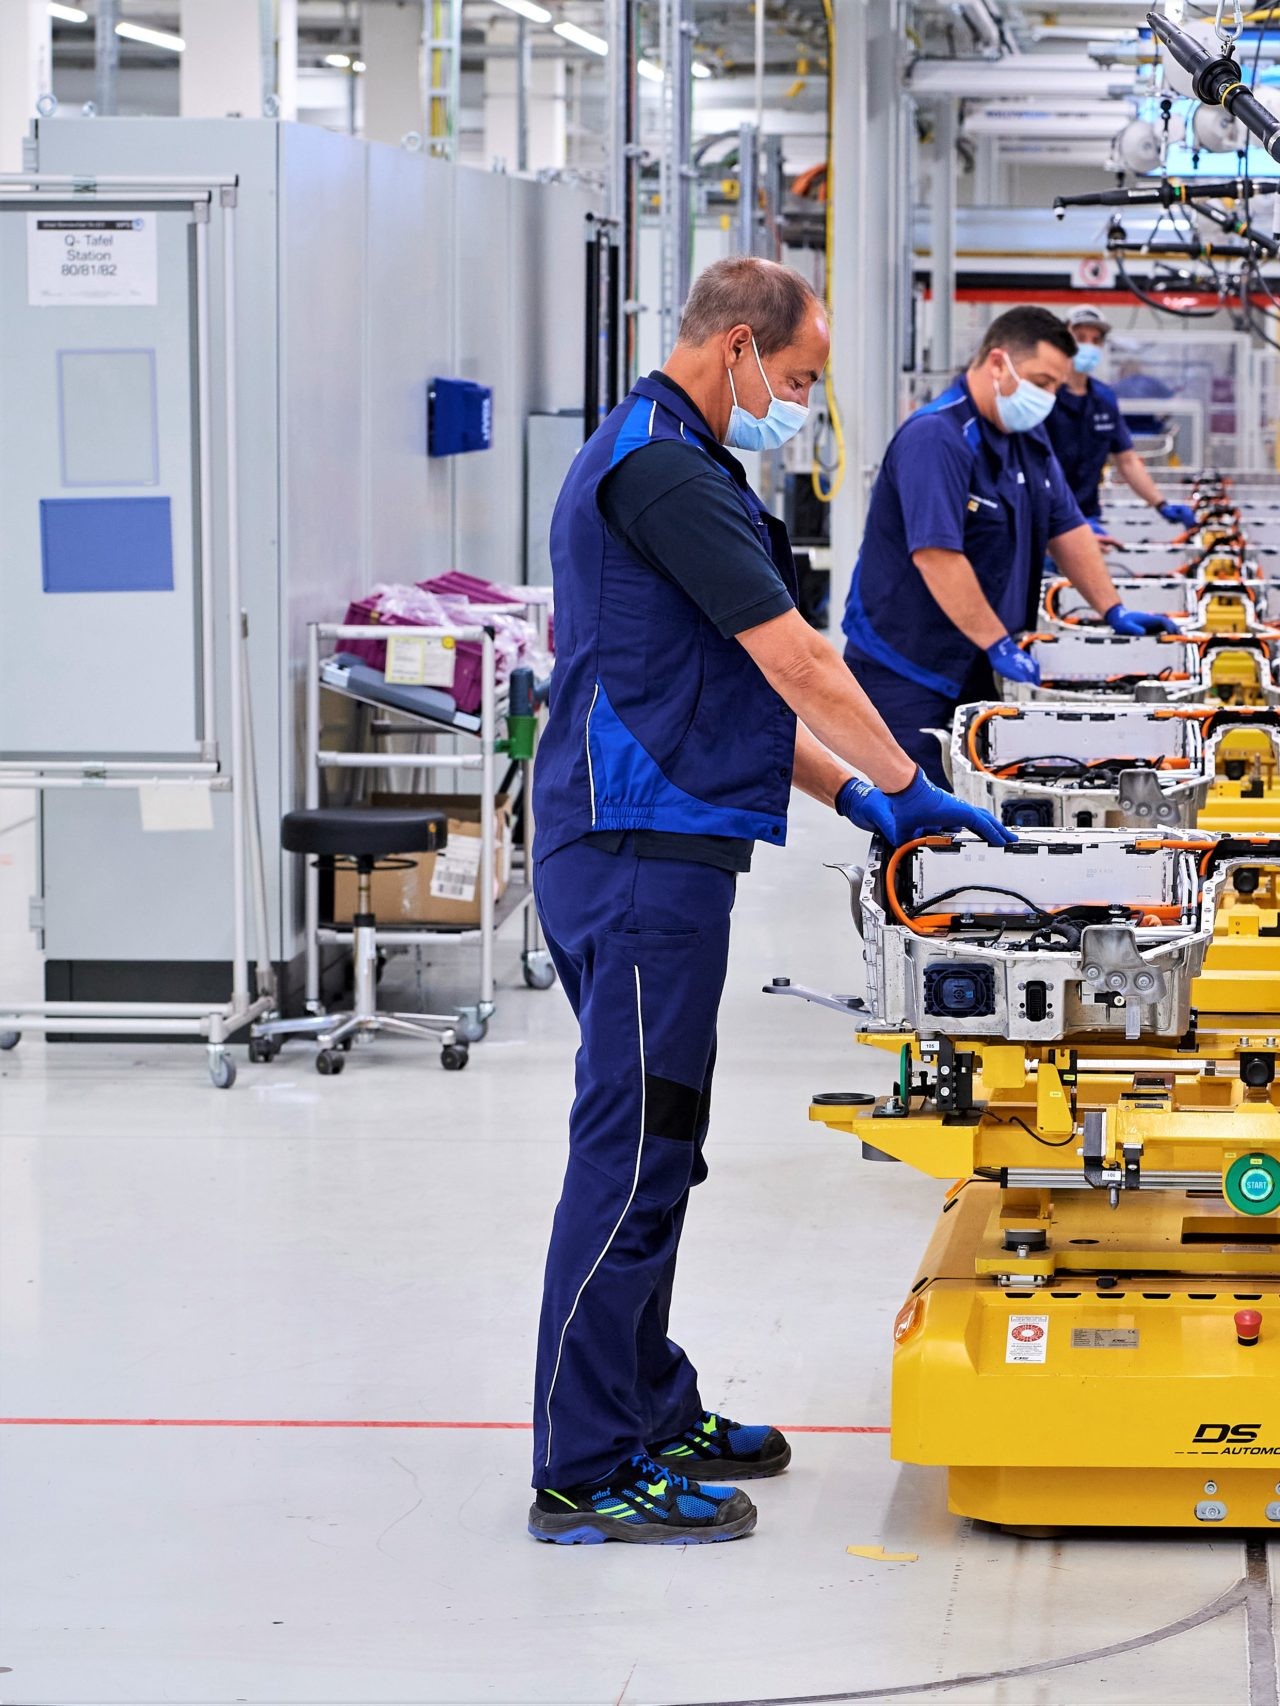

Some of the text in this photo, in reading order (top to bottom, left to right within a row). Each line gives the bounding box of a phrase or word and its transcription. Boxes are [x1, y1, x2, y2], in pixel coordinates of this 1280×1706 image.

[85, 234, 113, 246] Tafel
[66, 248, 111, 261] Station
[1246, 1181, 1267, 1190] START
[1192, 1423, 1262, 1444] DS
